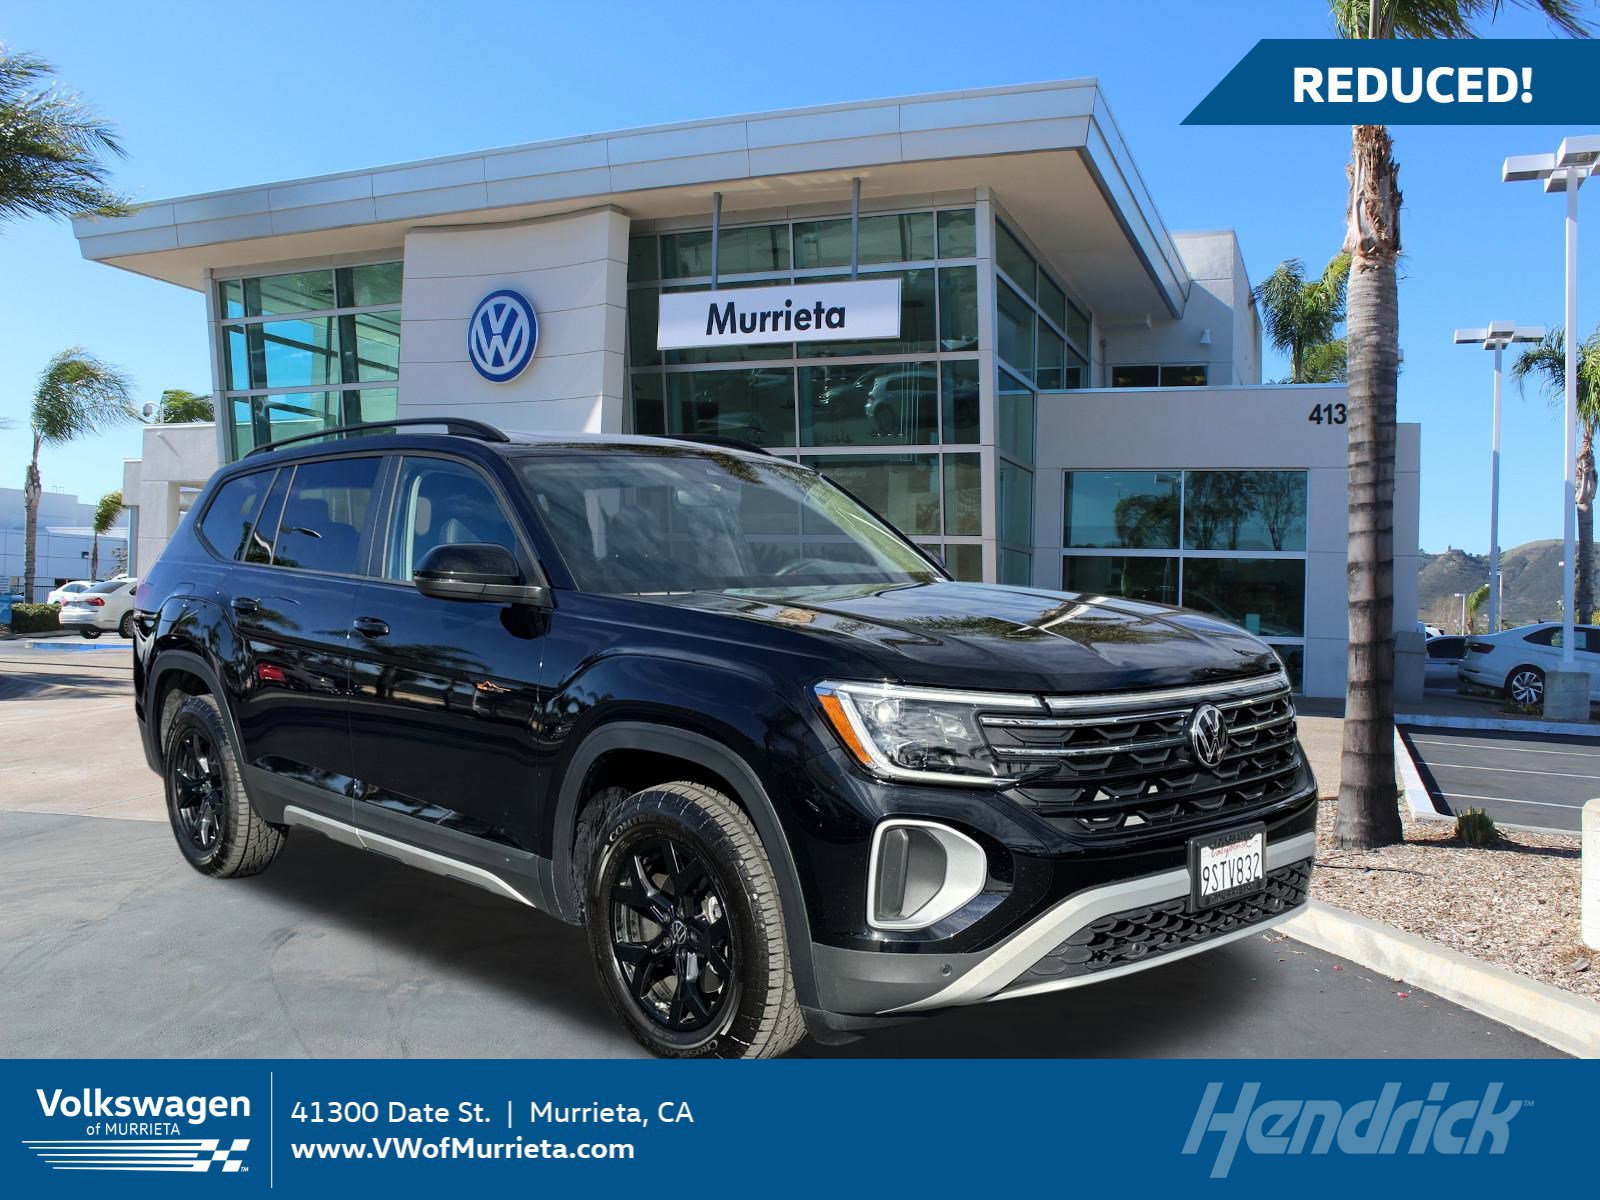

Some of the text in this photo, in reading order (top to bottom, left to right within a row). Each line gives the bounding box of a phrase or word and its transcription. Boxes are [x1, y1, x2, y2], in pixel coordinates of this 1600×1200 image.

[705, 299, 846, 336] Murrieta
[1308, 403, 1347, 425] 413
[1202, 851, 1260, 897] 9STV832
